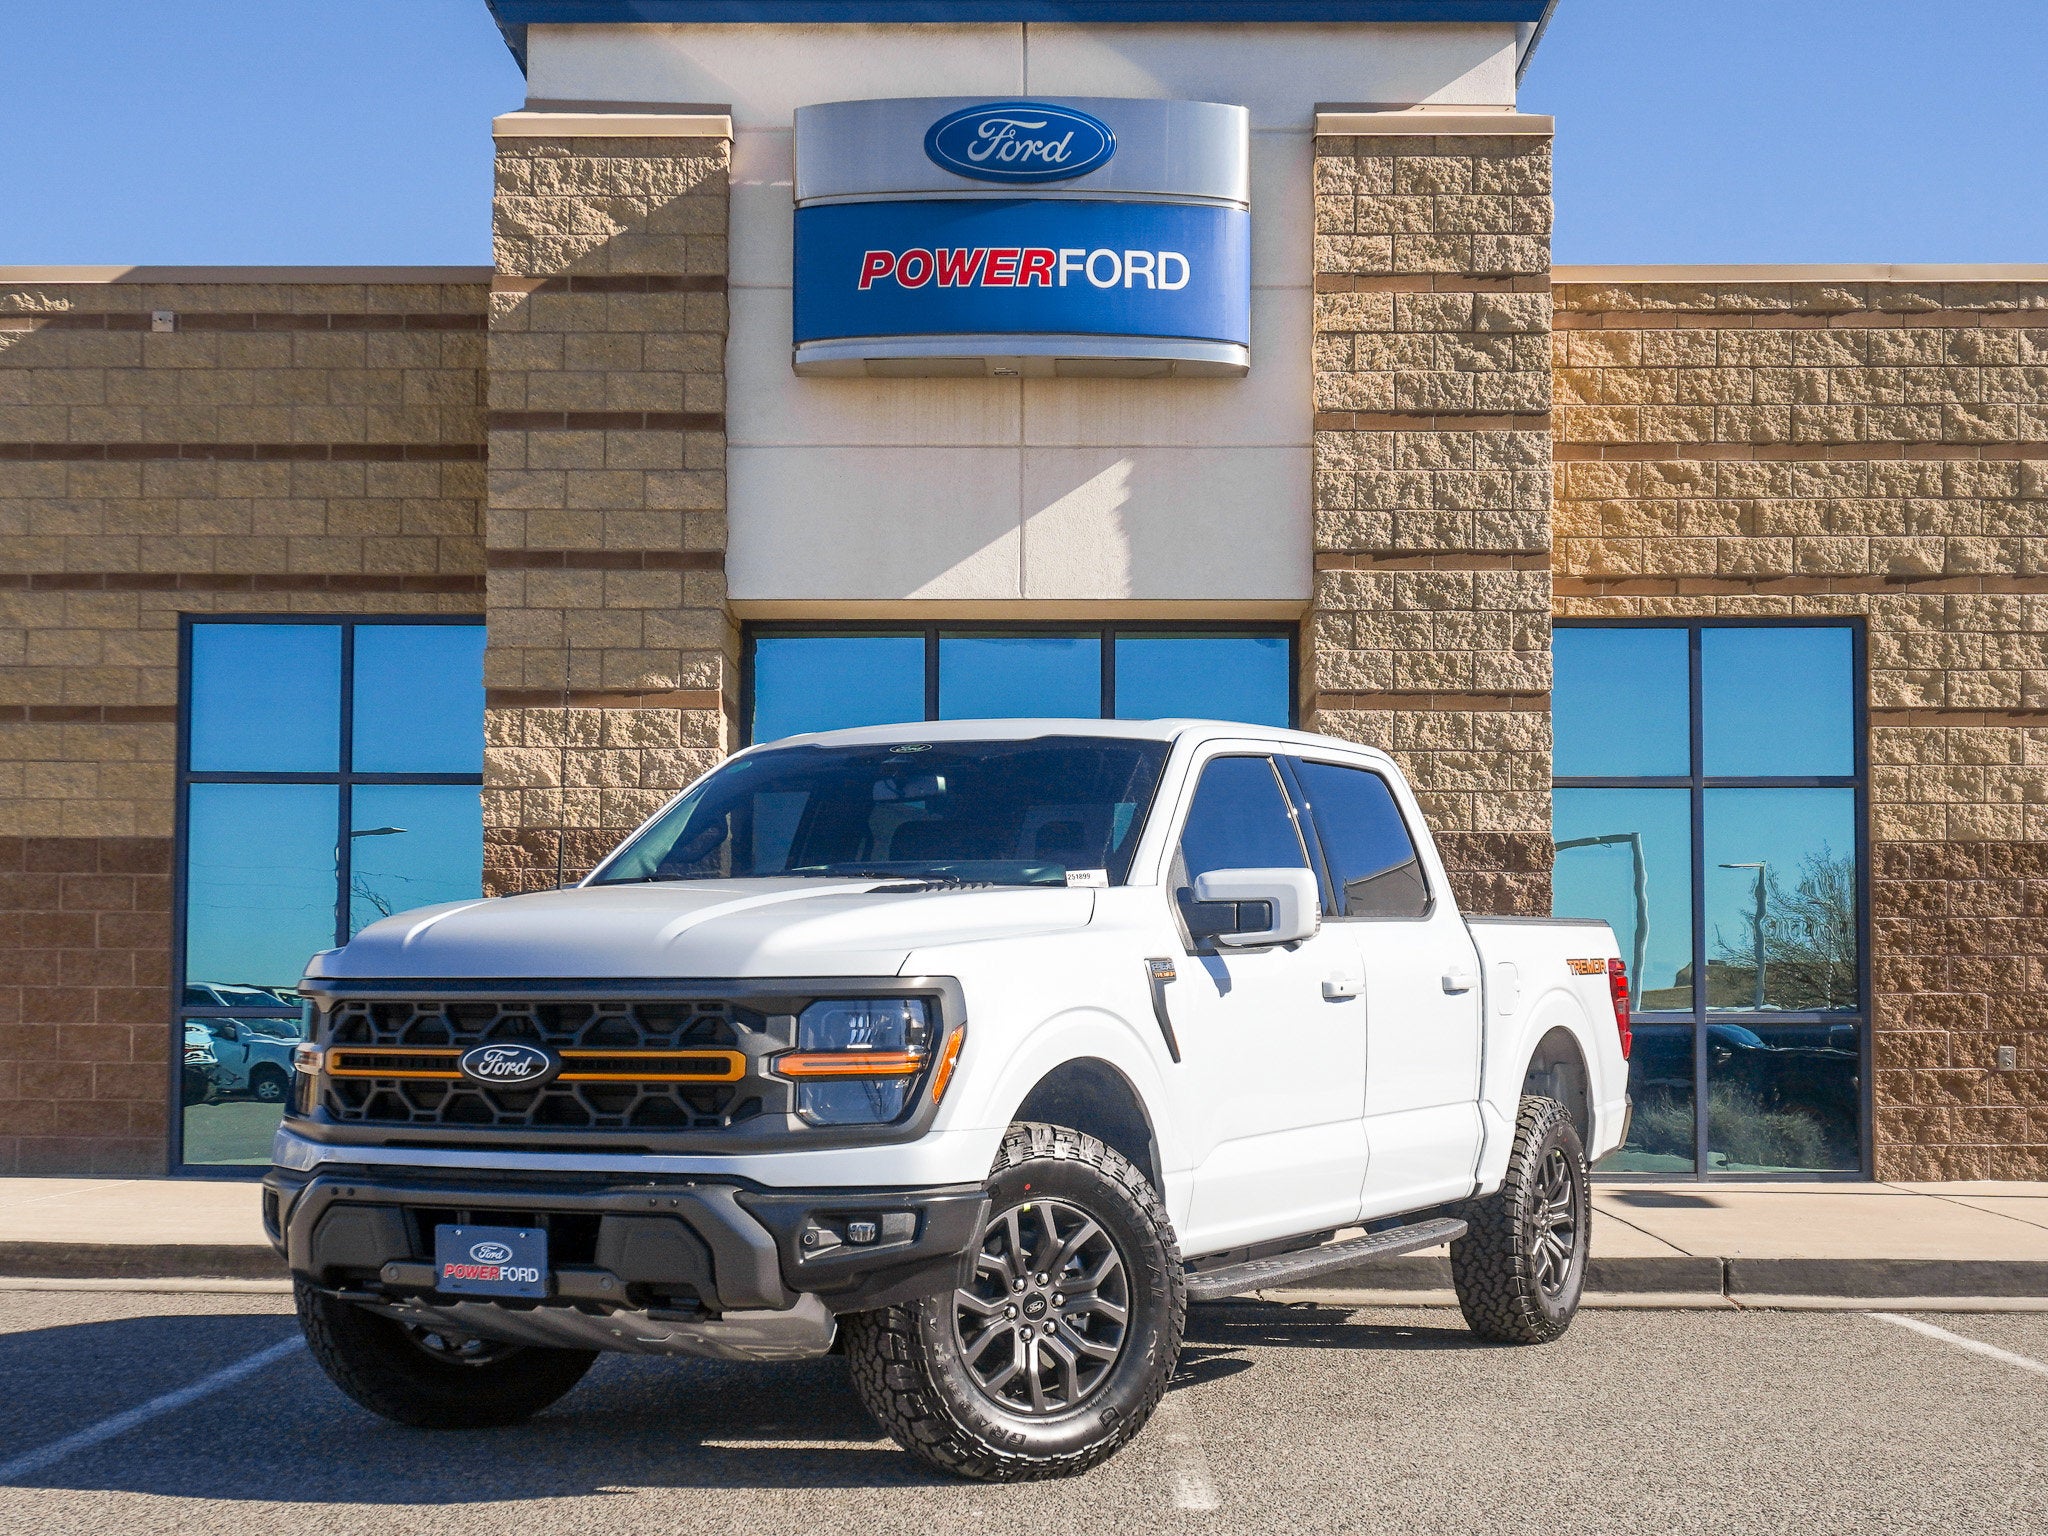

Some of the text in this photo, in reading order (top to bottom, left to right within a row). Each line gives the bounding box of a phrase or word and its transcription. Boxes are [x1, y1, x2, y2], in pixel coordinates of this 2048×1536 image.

[967, 118, 1074, 164] Ford
[857, 247, 1191, 291] POWERFORD
[1566, 958, 1607, 975] TREMOR
[478, 1049, 533, 1076] Ford
[478, 1245, 504, 1260] Ford
[443, 1262, 540, 1283] POWERFORD
